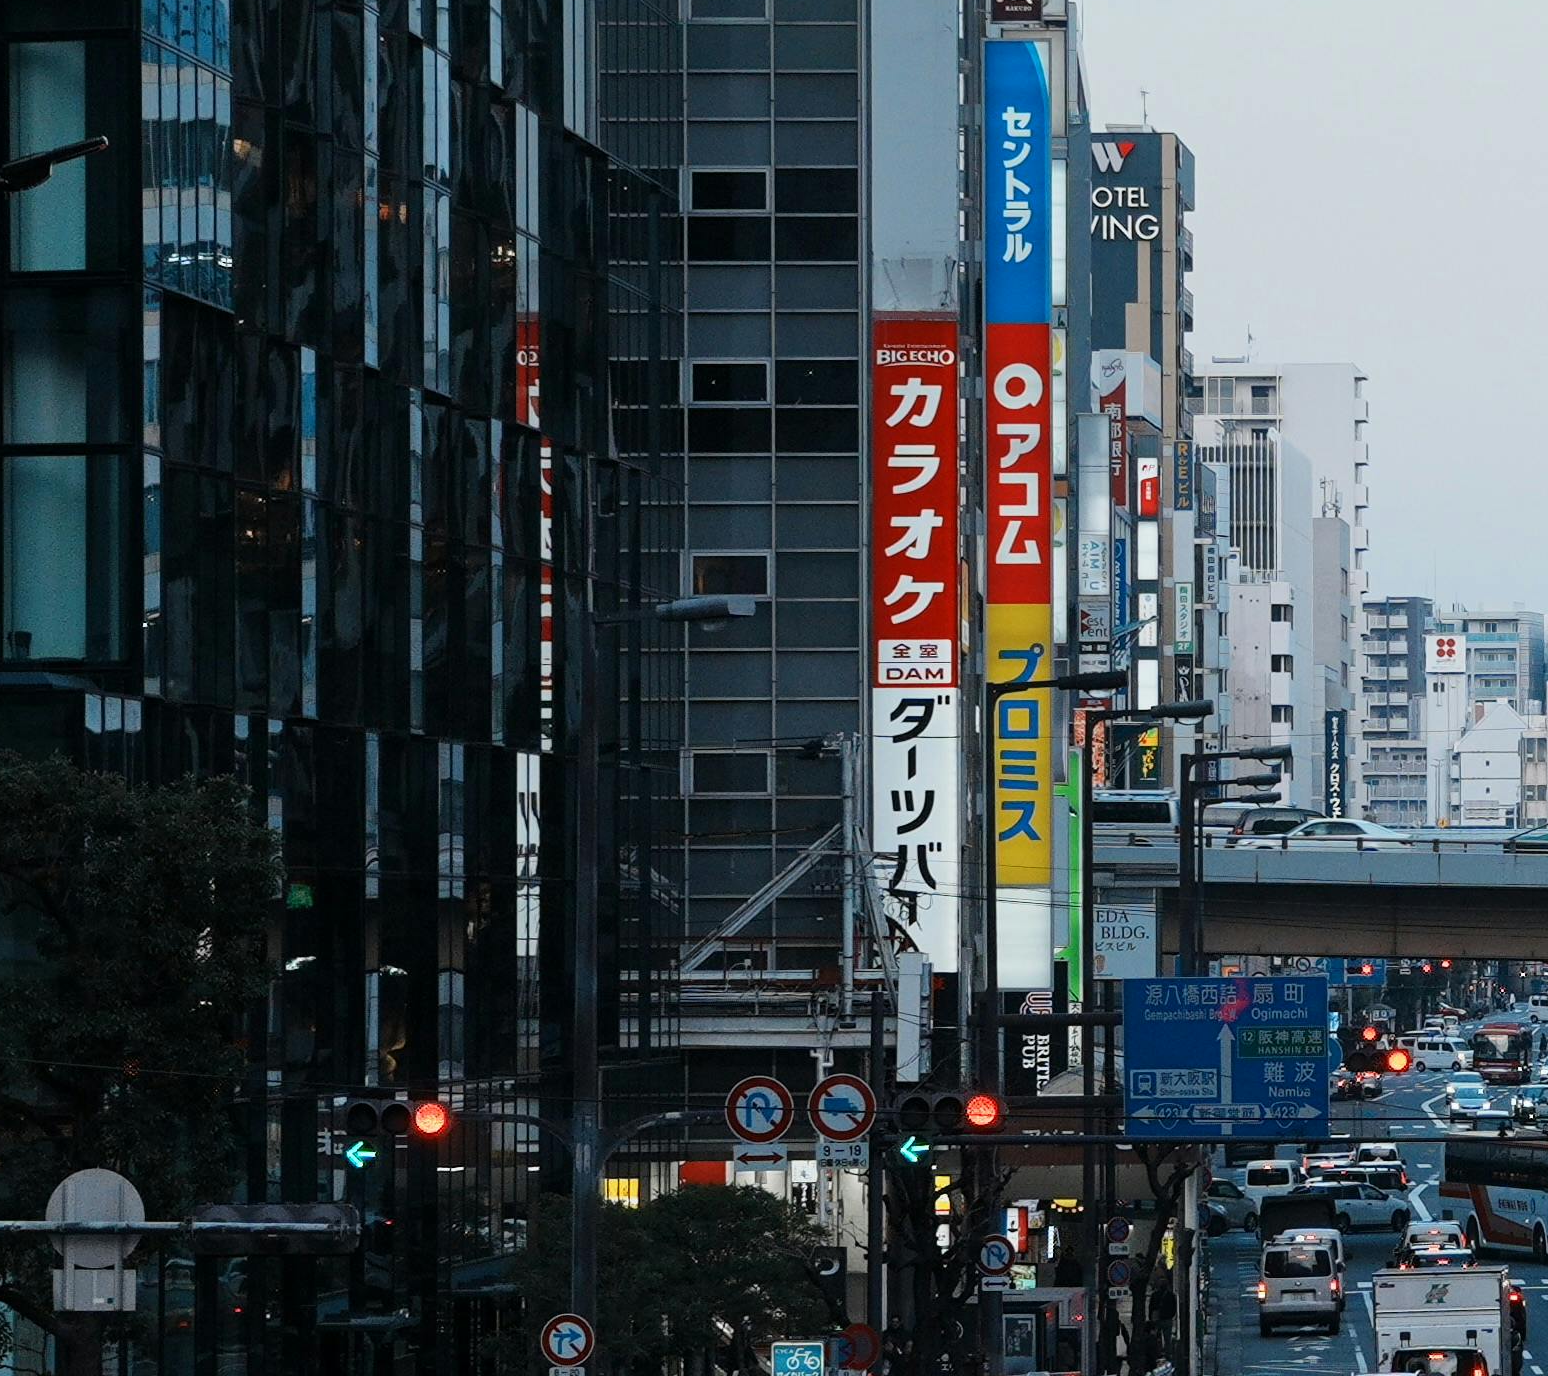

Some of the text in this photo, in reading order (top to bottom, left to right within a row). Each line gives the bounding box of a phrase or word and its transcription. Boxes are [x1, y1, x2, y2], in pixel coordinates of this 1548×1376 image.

[1002, 106, 1032, 263] セントラル
[1091, 187, 1149, 208] OTEL
[876, 351, 954, 365] BIG ECHO
[883, 377, 945, 625] カラオケ
[995, 423, 1042, 565] アコム
[1090, 541, 1099, 569] AIM
[892, 643, 939, 659] 全室
[1178, 642, 1190, 651] 2F
[885, 668, 944, 681] DAM
[998, 642, 1045, 842] プロミス
[1101, 926, 1150, 940] BLDG.
[1144, 984, 1238, 1007] 源八橋西詰
[1144, 1007, 1309, 1022] Gempachibashi Ogimachi
[1242, 1030, 1323, 1045] 12 阪神高速
[1022, 1034, 1036, 1069] PUB
[1258, 1045, 1324, 1055] HANSHIN EXP
[1159, 1071, 1215, 1087] 新大阪駅
[1268, 1086, 1311, 1098] Namba
[1157, 1108, 1180, 1120] 423
[1273, 1106, 1297, 1119] 423
